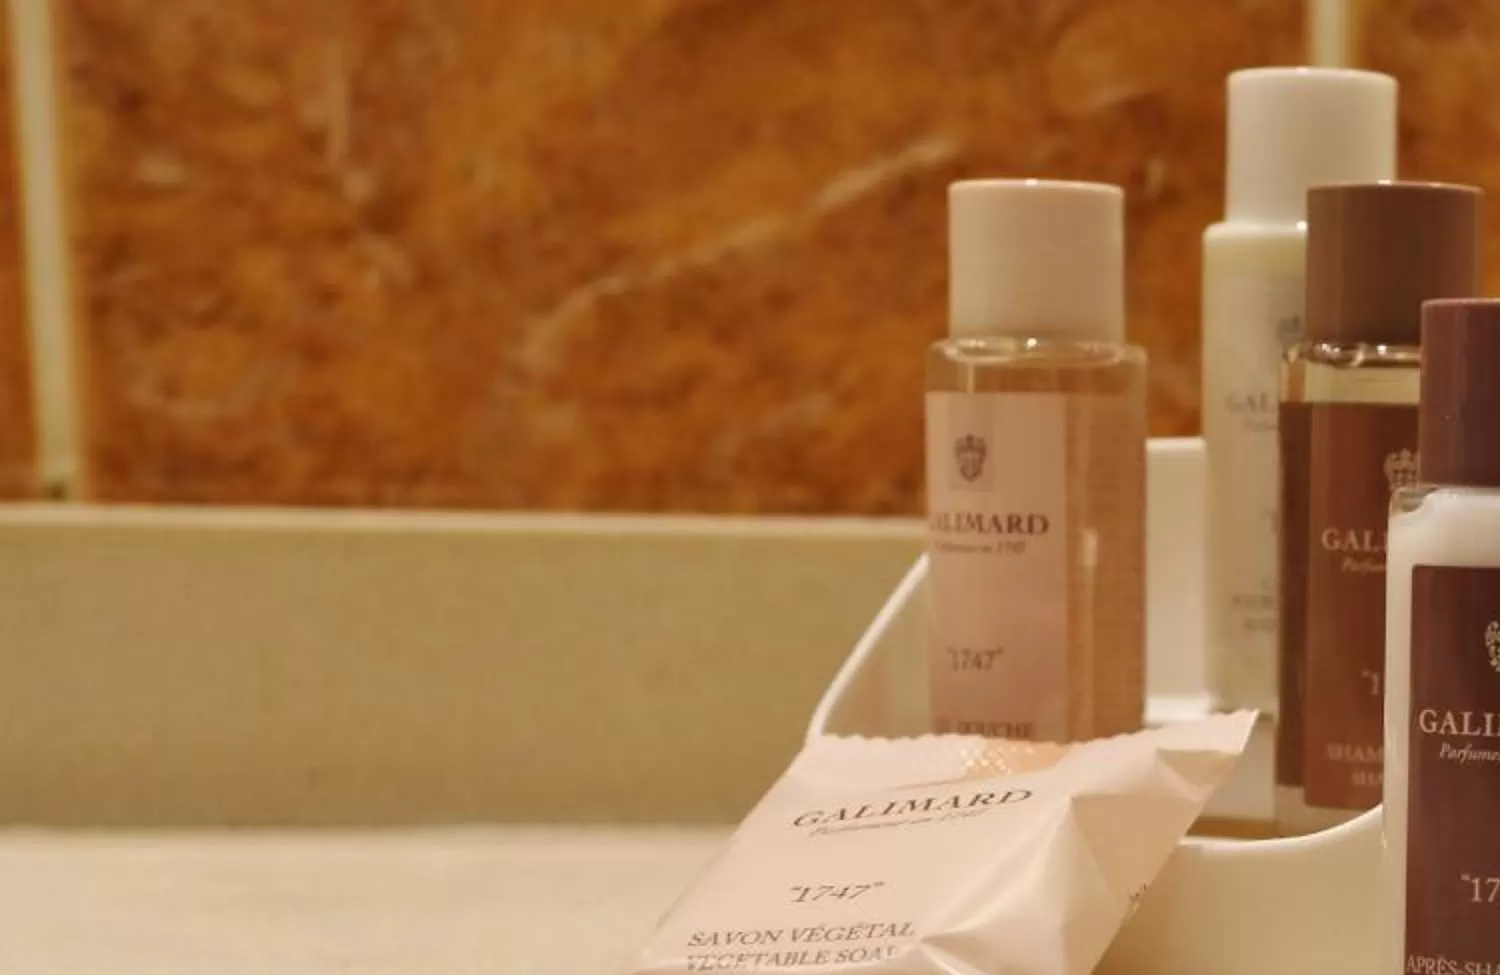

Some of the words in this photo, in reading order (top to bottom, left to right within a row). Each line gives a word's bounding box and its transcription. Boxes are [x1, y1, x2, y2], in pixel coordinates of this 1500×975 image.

[793, 788, 1034, 829] GALIMARD
[687, 929, 785, 949] SAVON
[791, 922, 916, 944] VÉGÉTAL
